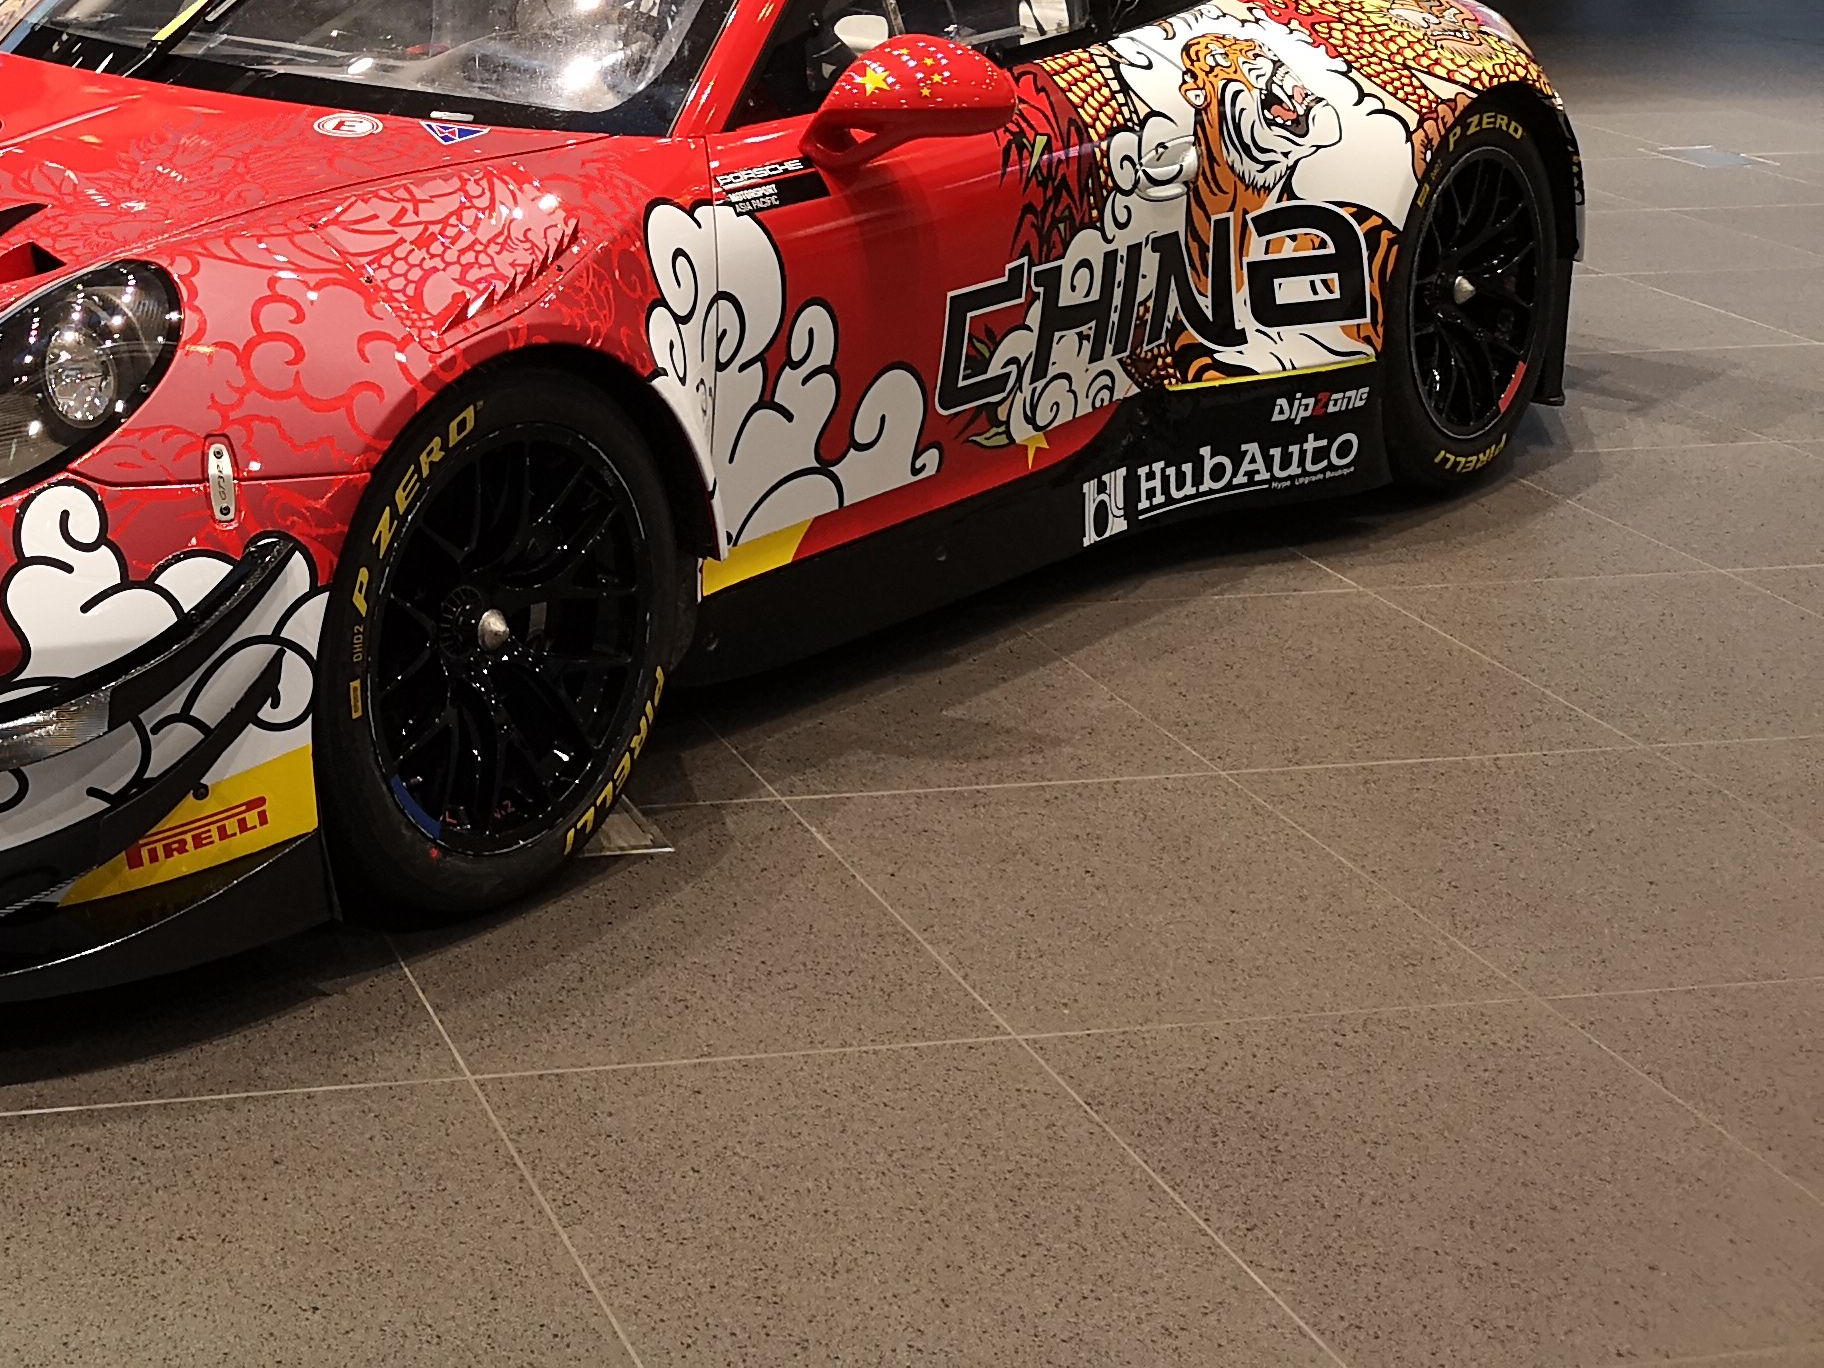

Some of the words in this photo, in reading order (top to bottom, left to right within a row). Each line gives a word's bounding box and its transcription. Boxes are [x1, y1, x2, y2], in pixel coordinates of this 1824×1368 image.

[716, 159, 803, 186] PORSCHE
[735, 199, 753, 213] ASIA
[752, 195, 780, 209] PACIFIC
[1137, 432, 1359, 511] HubAuto
[1434, 433, 1507, 472] PIRELLI
[372, 404, 475, 559] ZERO
[125, 795, 269, 870] PIRELLI
